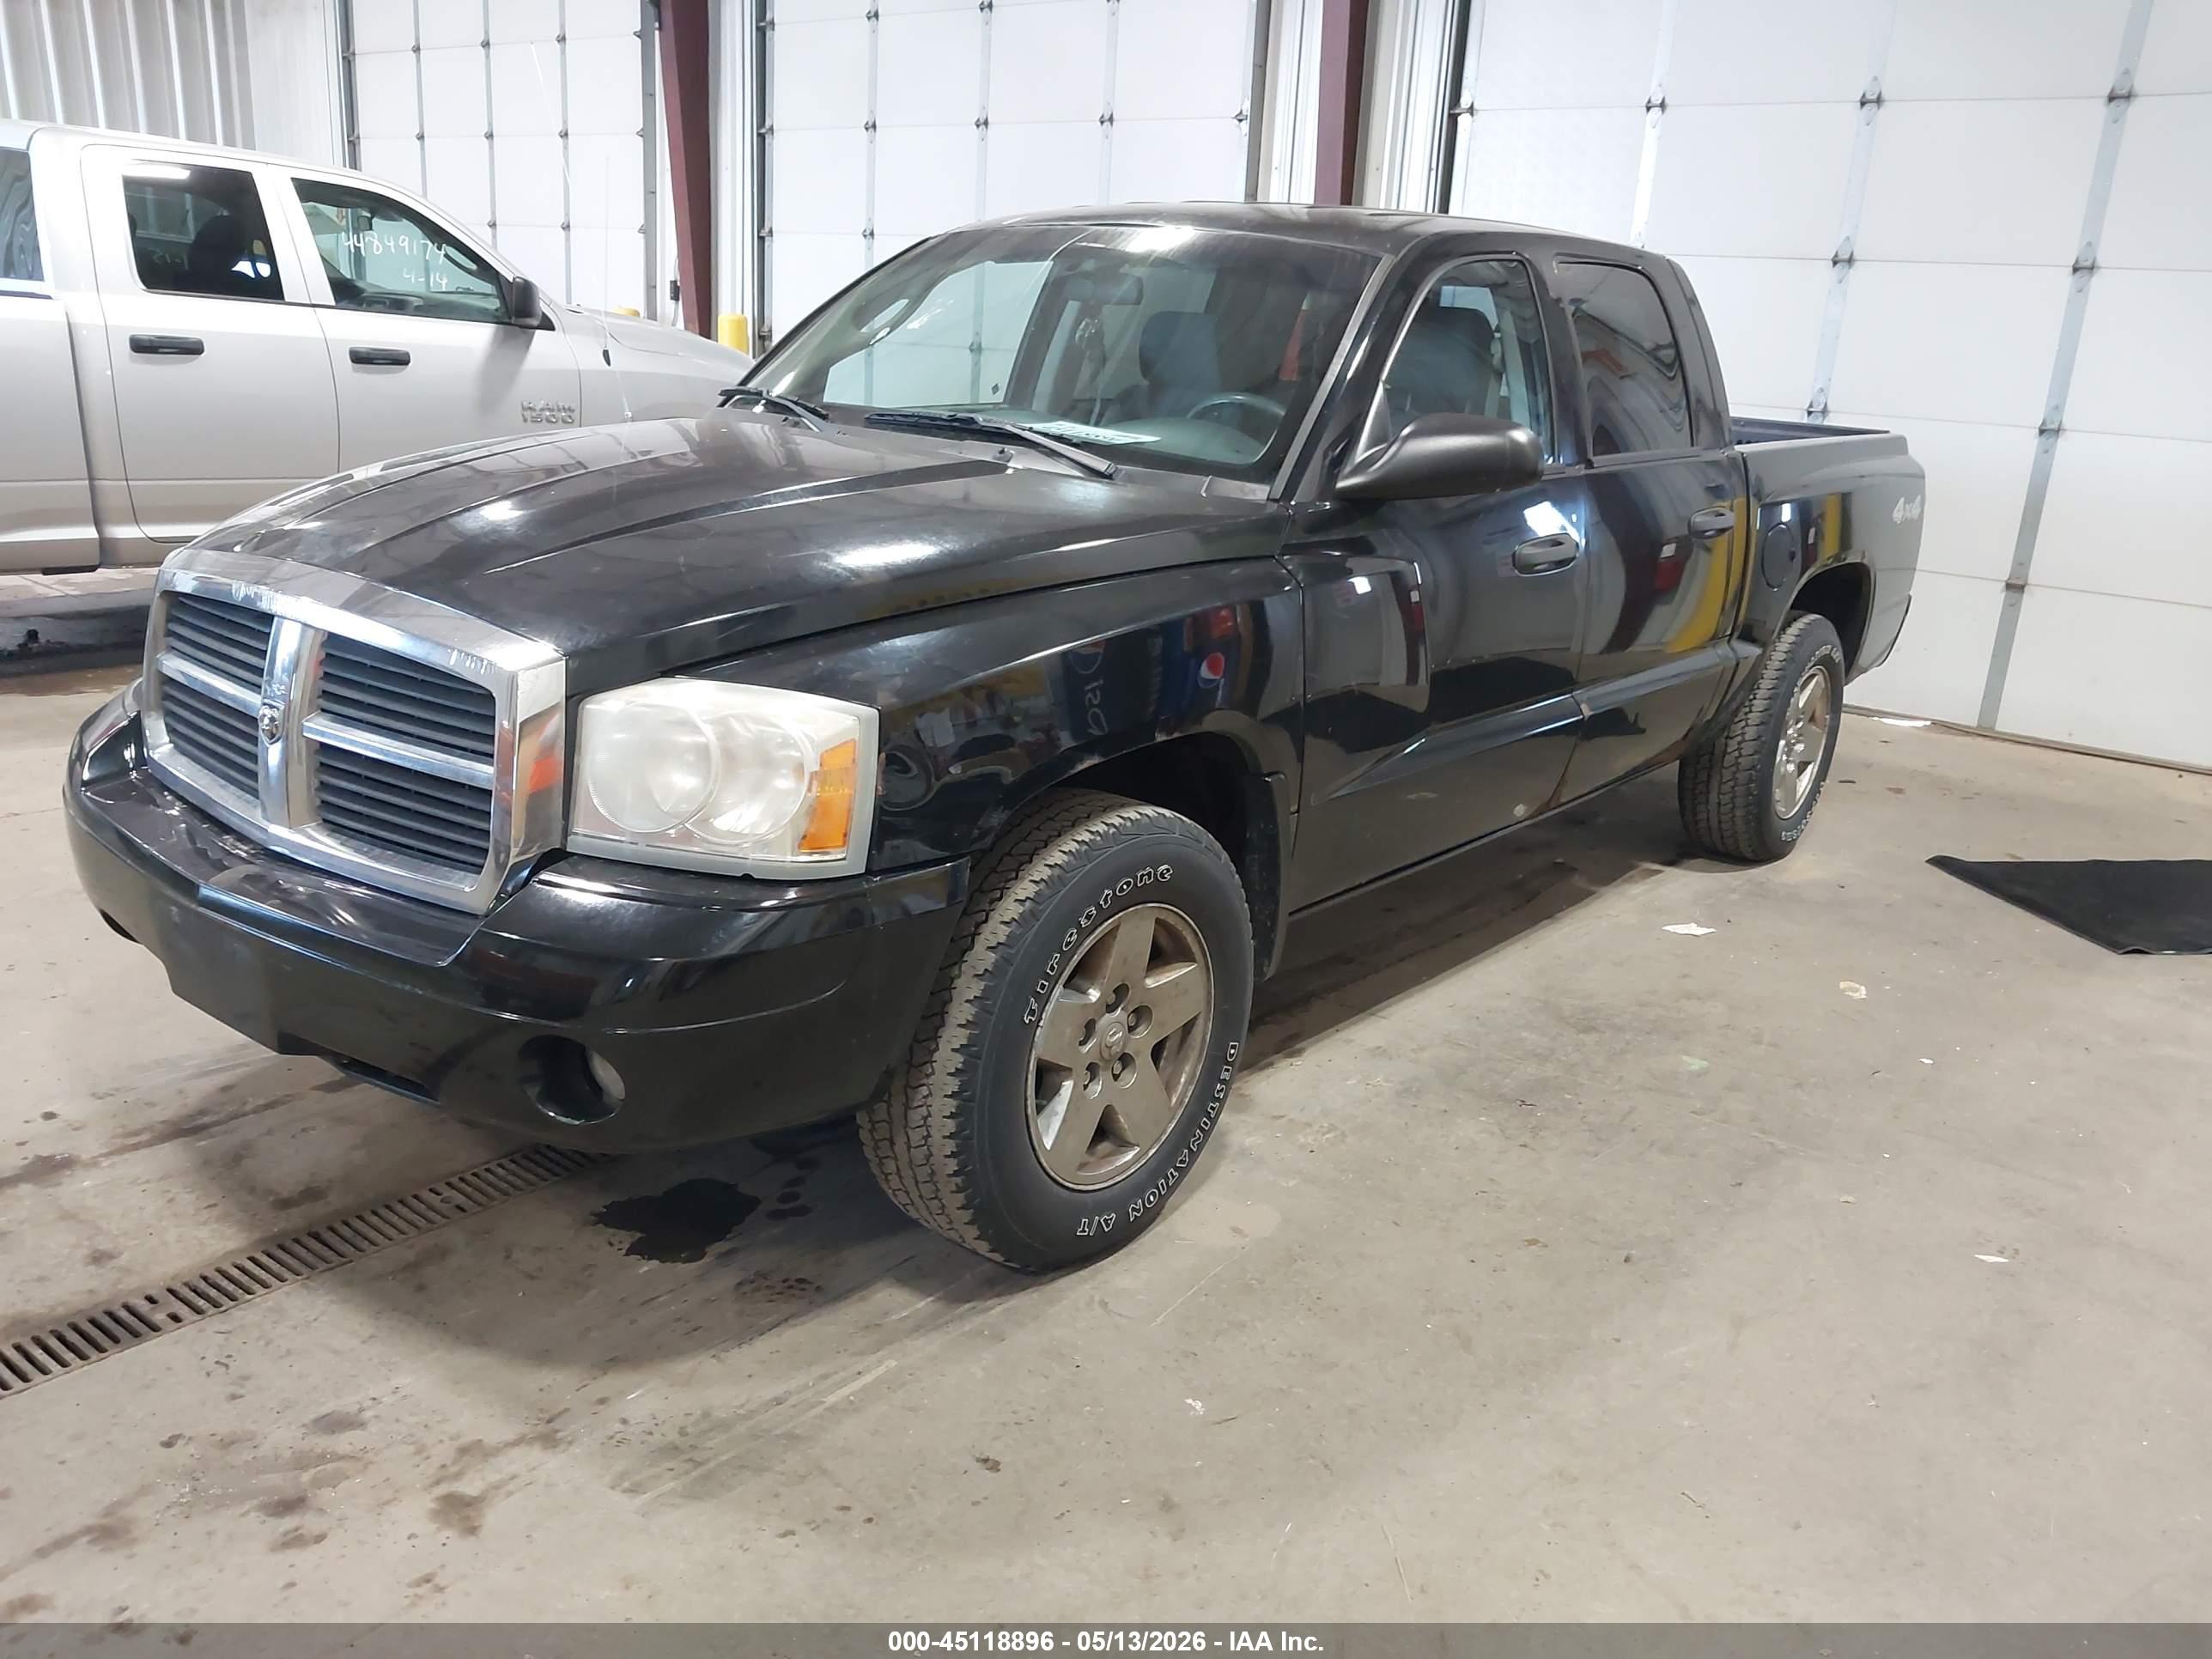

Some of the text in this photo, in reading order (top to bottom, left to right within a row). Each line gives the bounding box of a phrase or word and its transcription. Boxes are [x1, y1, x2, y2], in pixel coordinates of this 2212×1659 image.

[342, 231, 447, 264] 44849174
[403, 268, 448, 291] 4-14
[1076, 1042, 1239, 1237] DESTINATION A/T
